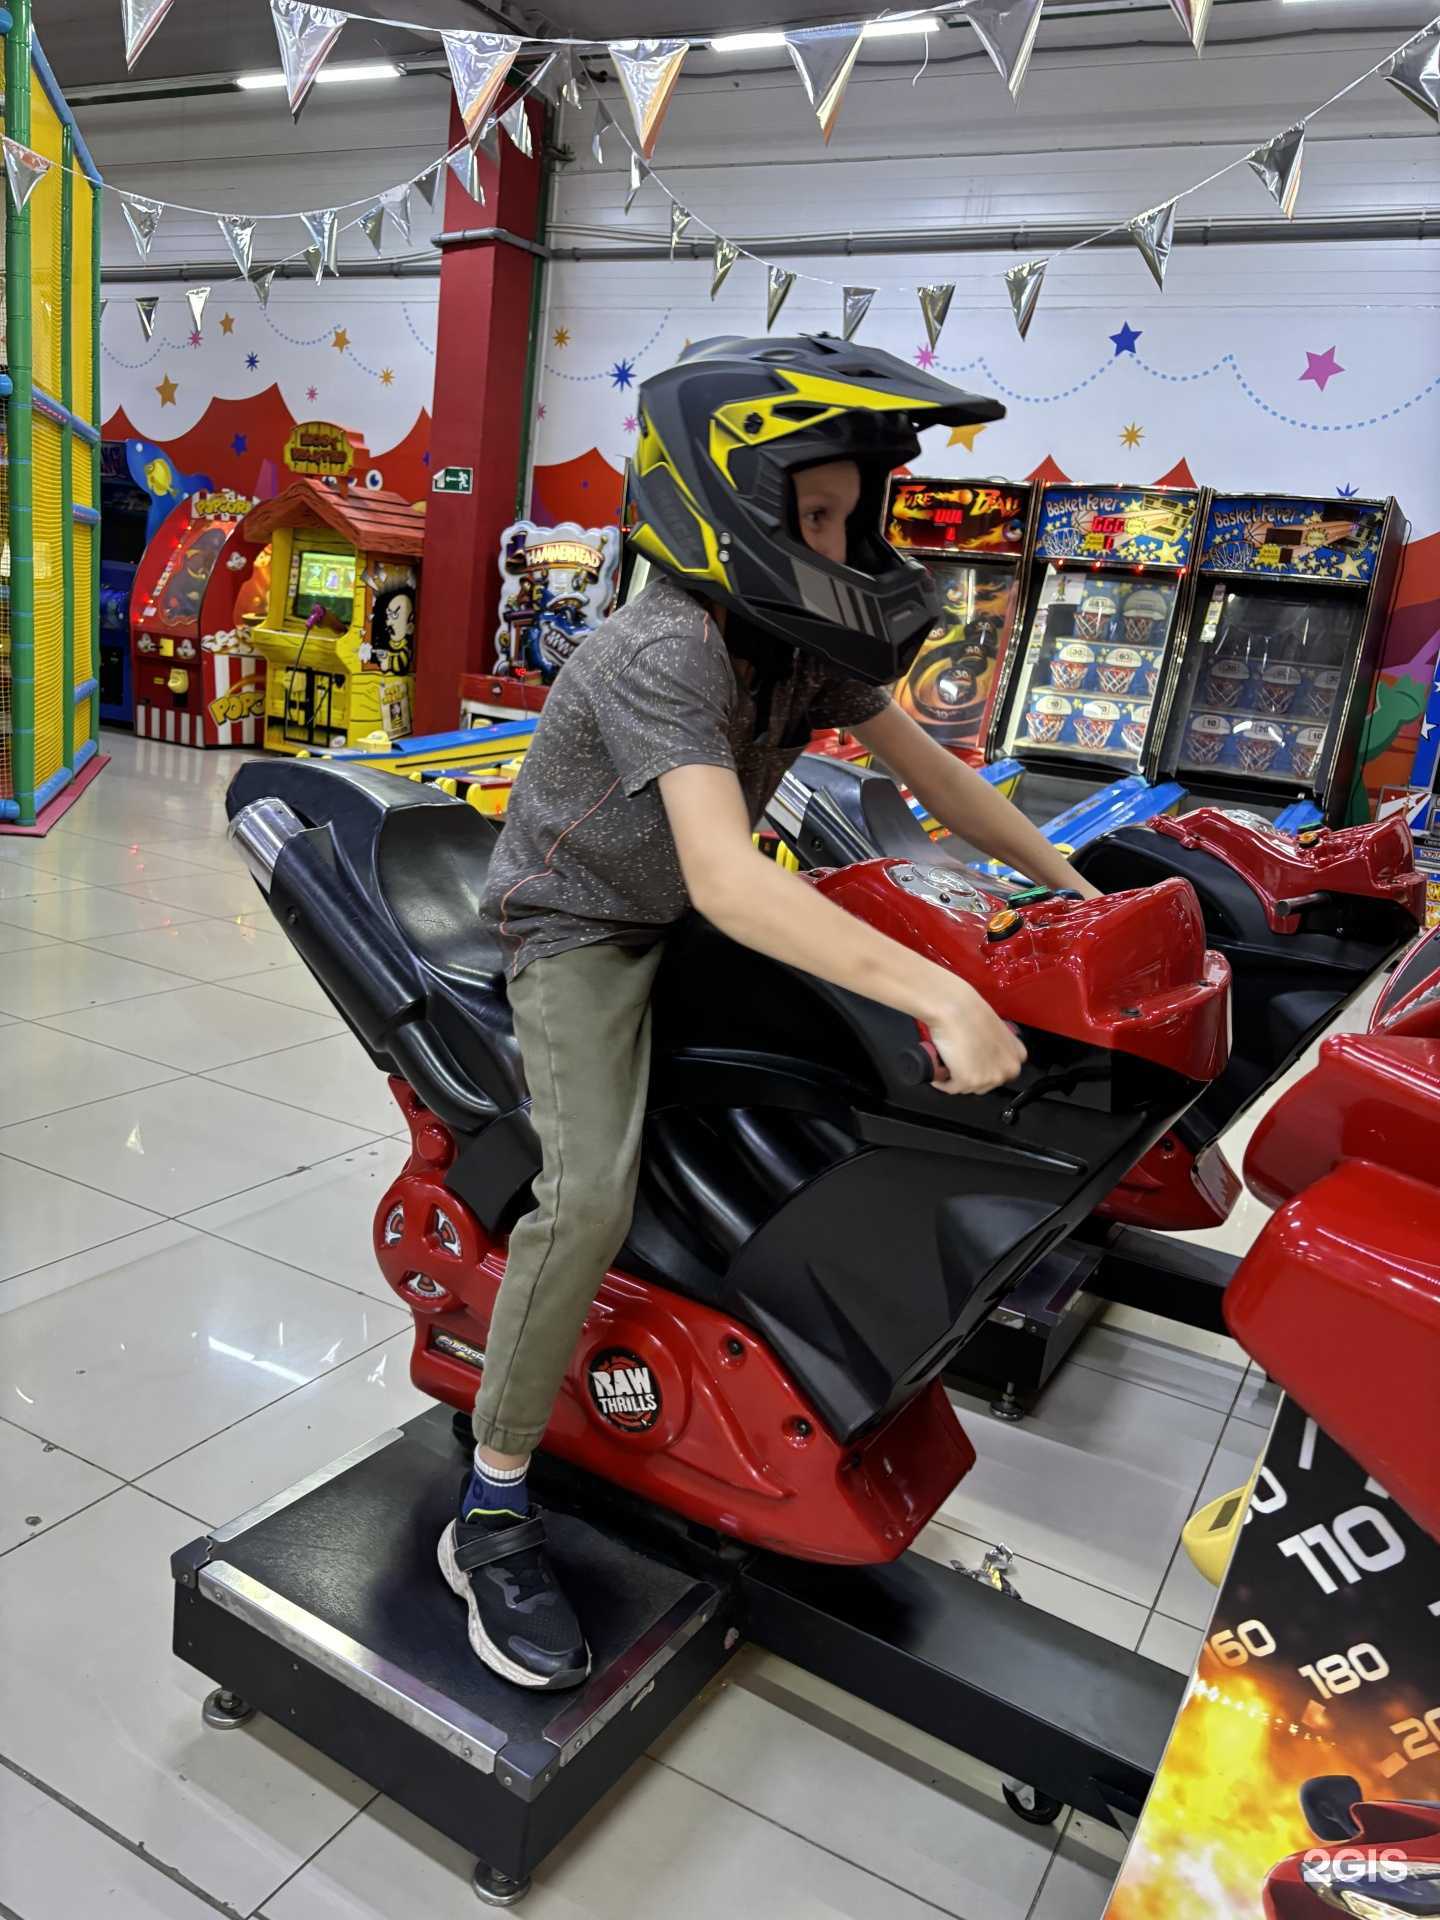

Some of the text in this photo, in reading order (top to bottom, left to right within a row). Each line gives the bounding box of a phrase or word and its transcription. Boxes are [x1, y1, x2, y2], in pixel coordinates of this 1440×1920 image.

[1086, 493, 1117, 512] Fever
[1214, 504, 1296, 529] Basket Fever
[526, 544, 601, 568] HAMMERHEAD
[591, 1367, 652, 1397] RAW
[598, 1393, 658, 1413] THRILLS
[1277, 1505, 1406, 1595] 110
[1298, 1643, 1390, 1699] 180
